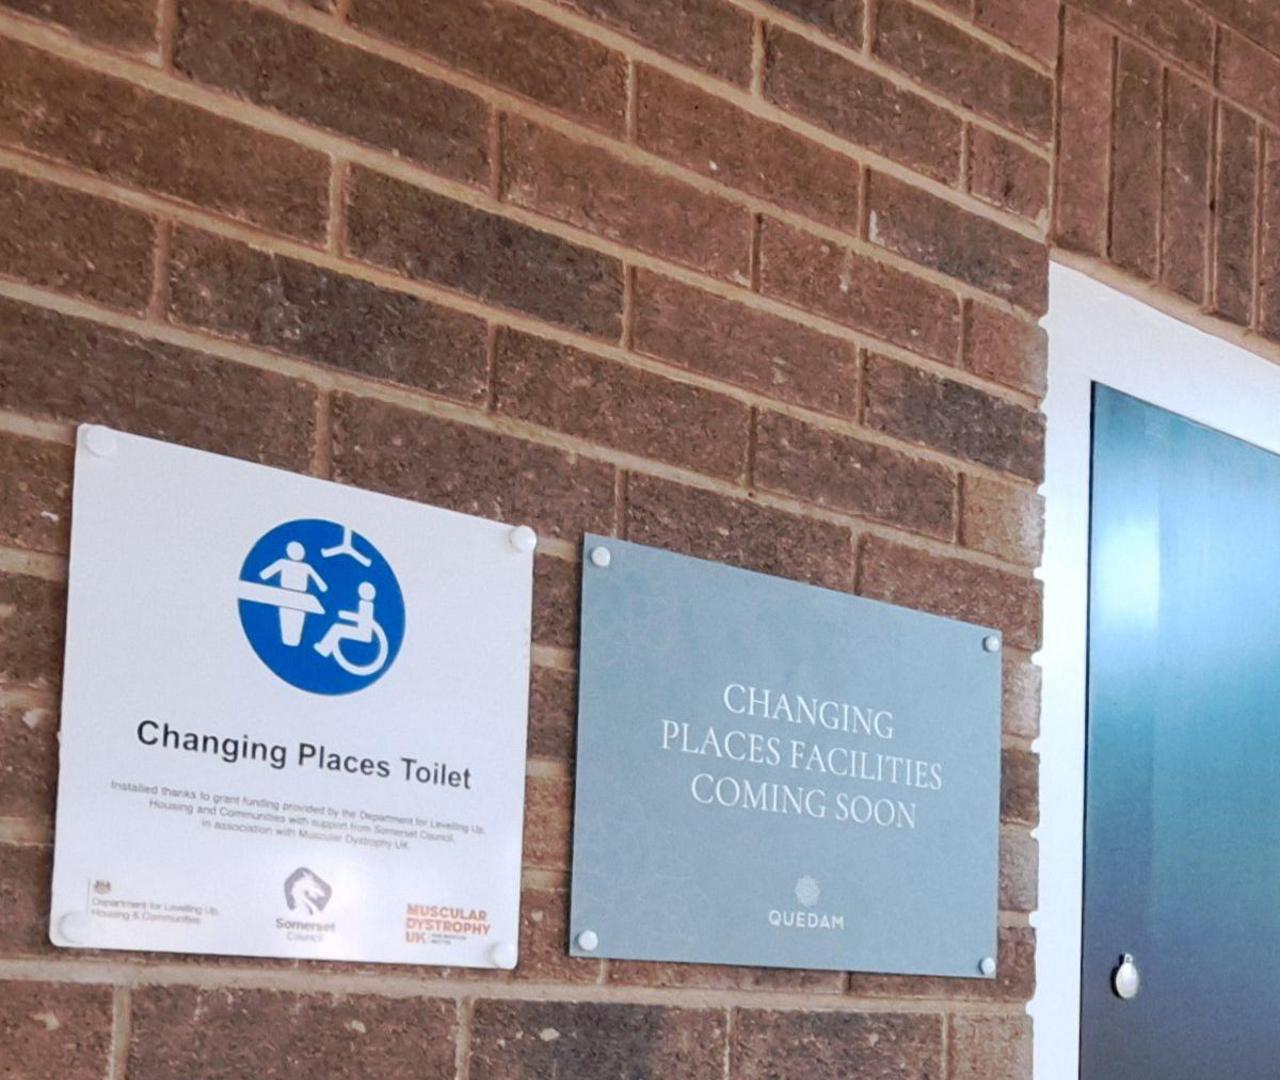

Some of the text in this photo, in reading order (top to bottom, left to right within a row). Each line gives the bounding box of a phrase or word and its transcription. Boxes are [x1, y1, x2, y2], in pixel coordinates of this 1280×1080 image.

[723, 684, 894, 739] CHANGING
[137, 720, 472, 790] Changing Places Toilet
[661, 719, 943, 790] PLACES FACILITIES
[111, 780, 158, 795] Installed
[161, 786, 196, 799] thanks
[200, 792, 210, 801] to
[213, 794, 240, 804] grant
[243, 797, 280, 811] funding
[282, 801, 325, 816] provided
[328, 807, 339, 817] by
[342, 809, 356, 818] the
[360, 811, 413, 825] Department
[416, 817, 427, 826] for
[430, 820, 469, 834] Levelling
[691, 773, 916, 829] COMING SOON
[149, 799, 194, 815] Housing
[197, 806, 216, 816] and
[220, 806, 286, 823] Communities
[289, 816, 309, 825] with
[311, 818, 348, 830] support
[351, 822, 371, 831] from
[374, 825, 417, 838] Somerset
[202, 819, 211, 828] in
[214, 821, 272, 835] association
[276, 828, 296, 837] with
[298, 829, 342, 842] Muscular
[345, 834, 391, 849] Dystrophy
[92, 898, 147, 910] Department
[406, 903, 487, 920] MUSCULAR
[275, 918, 336, 932] Somerset
[406, 917, 491, 935] DYSTROPHY
[768, 910, 845, 930] QUEDAM
[406, 931, 426, 943] UK
